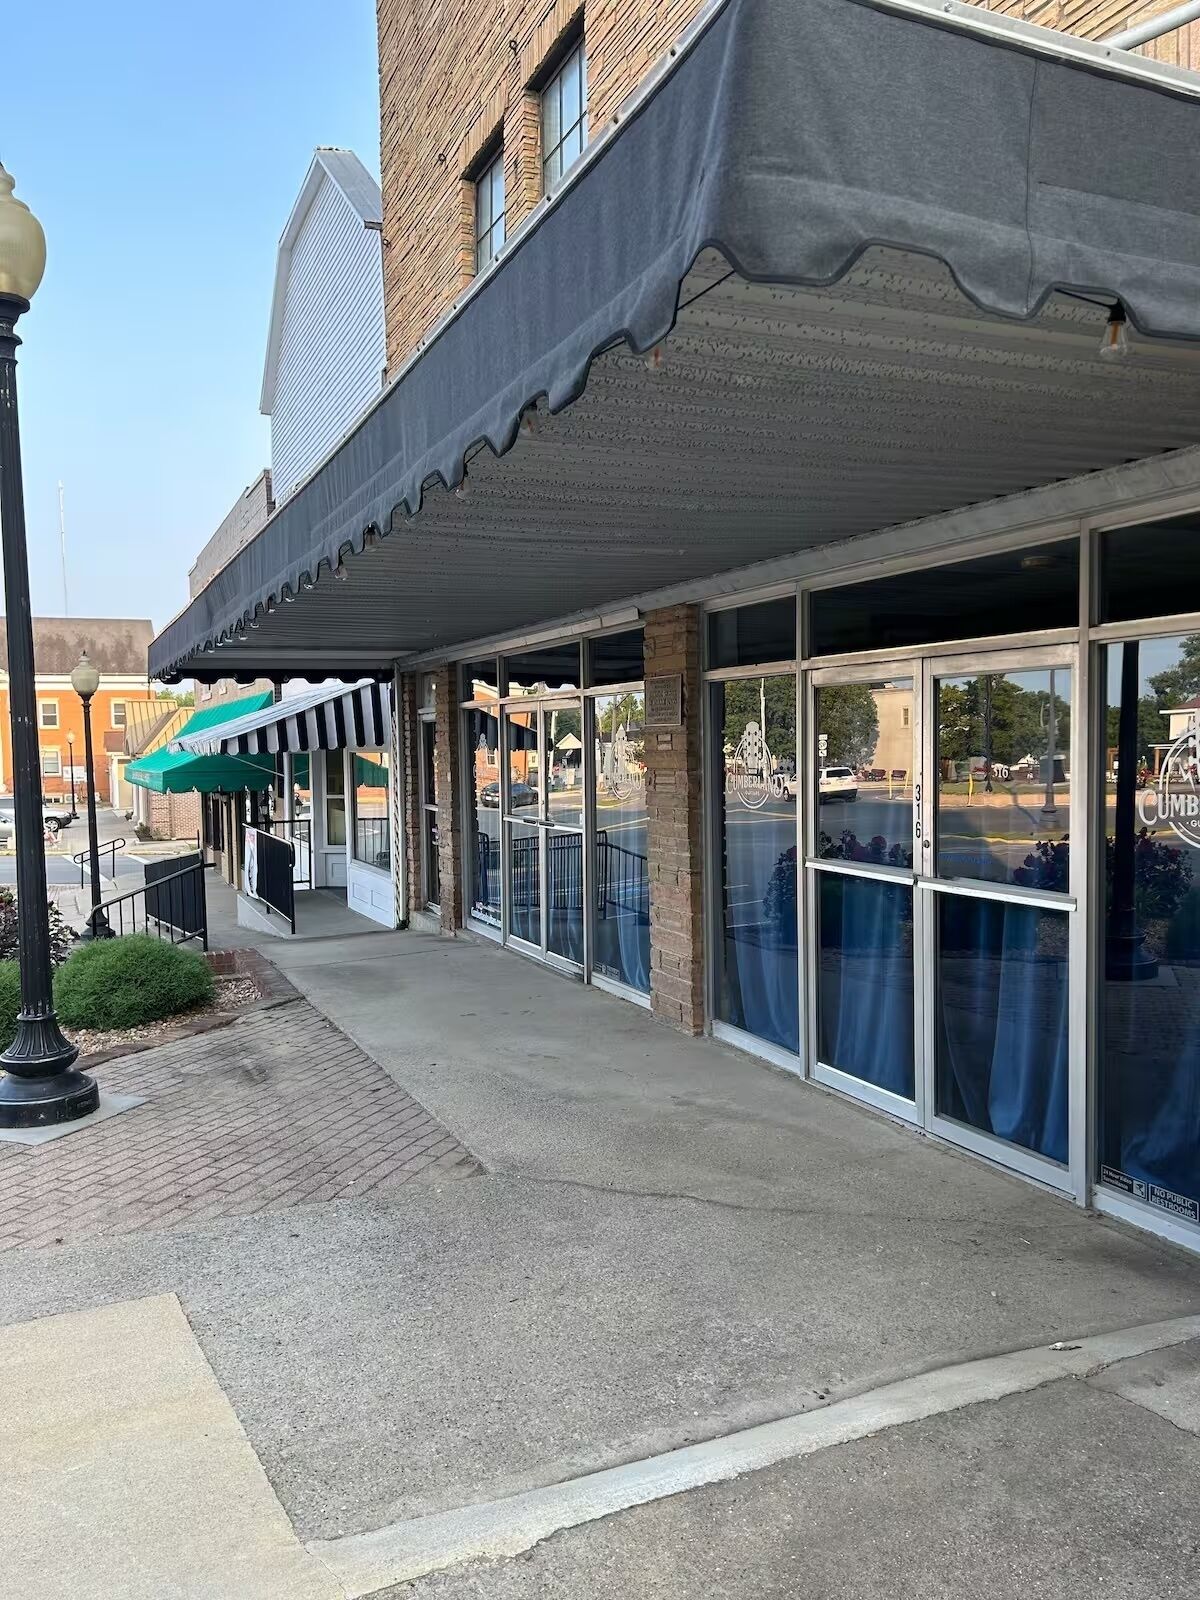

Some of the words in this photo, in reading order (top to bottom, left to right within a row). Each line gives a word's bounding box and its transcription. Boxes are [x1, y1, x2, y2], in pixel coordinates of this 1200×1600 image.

[1138, 789, 1200, 826] CUMB
[1151, 1194, 1196, 1219] RESTROOMS
[1154, 1187, 1166, 1198] NO
[1166, 1191, 1193, 1209] PUBLIC
